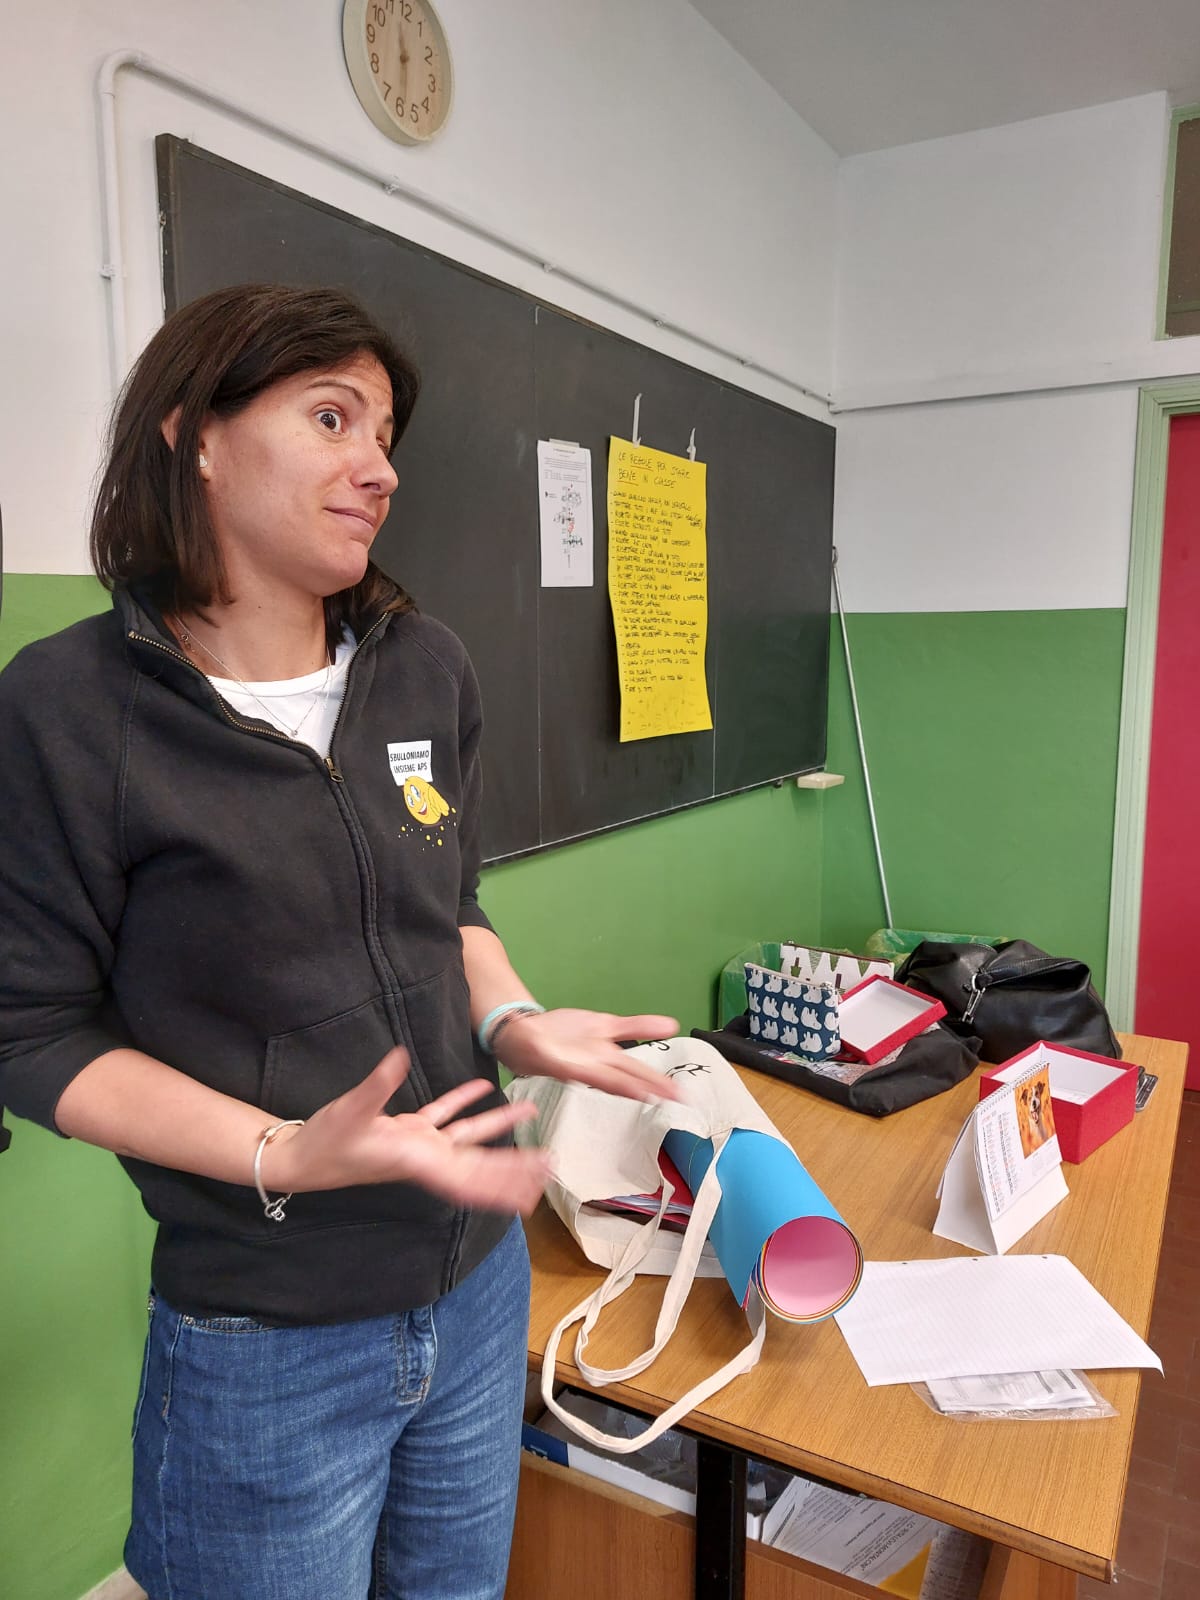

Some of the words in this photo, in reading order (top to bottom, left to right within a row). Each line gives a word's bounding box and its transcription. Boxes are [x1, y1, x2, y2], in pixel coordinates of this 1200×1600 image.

[372, 4, 386, 27] 10
[399, 0, 412, 23] 12
[366, 23, 376, 43] 9
[417, 21, 422, 38] 1
[370, 52, 380, 74] 8
[424, 46, 433, 66] 2
[383, 81, 392, 101] 7
[427, 73, 436, 93] 3
[395, 97, 405, 118] 6
[410, 103, 419, 123] 5
[421, 96, 430, 114] 4
[618, 452, 627, 461] LE
[630, 454, 653, 469] REGOLE
[618, 468, 637, 481] BENE
[653, 476, 678, 489] CLASSE
[390, 750, 430, 762] SBULLONIAMO
[393, 763, 416, 774] INSIEME
[417, 762, 428, 771] APS
